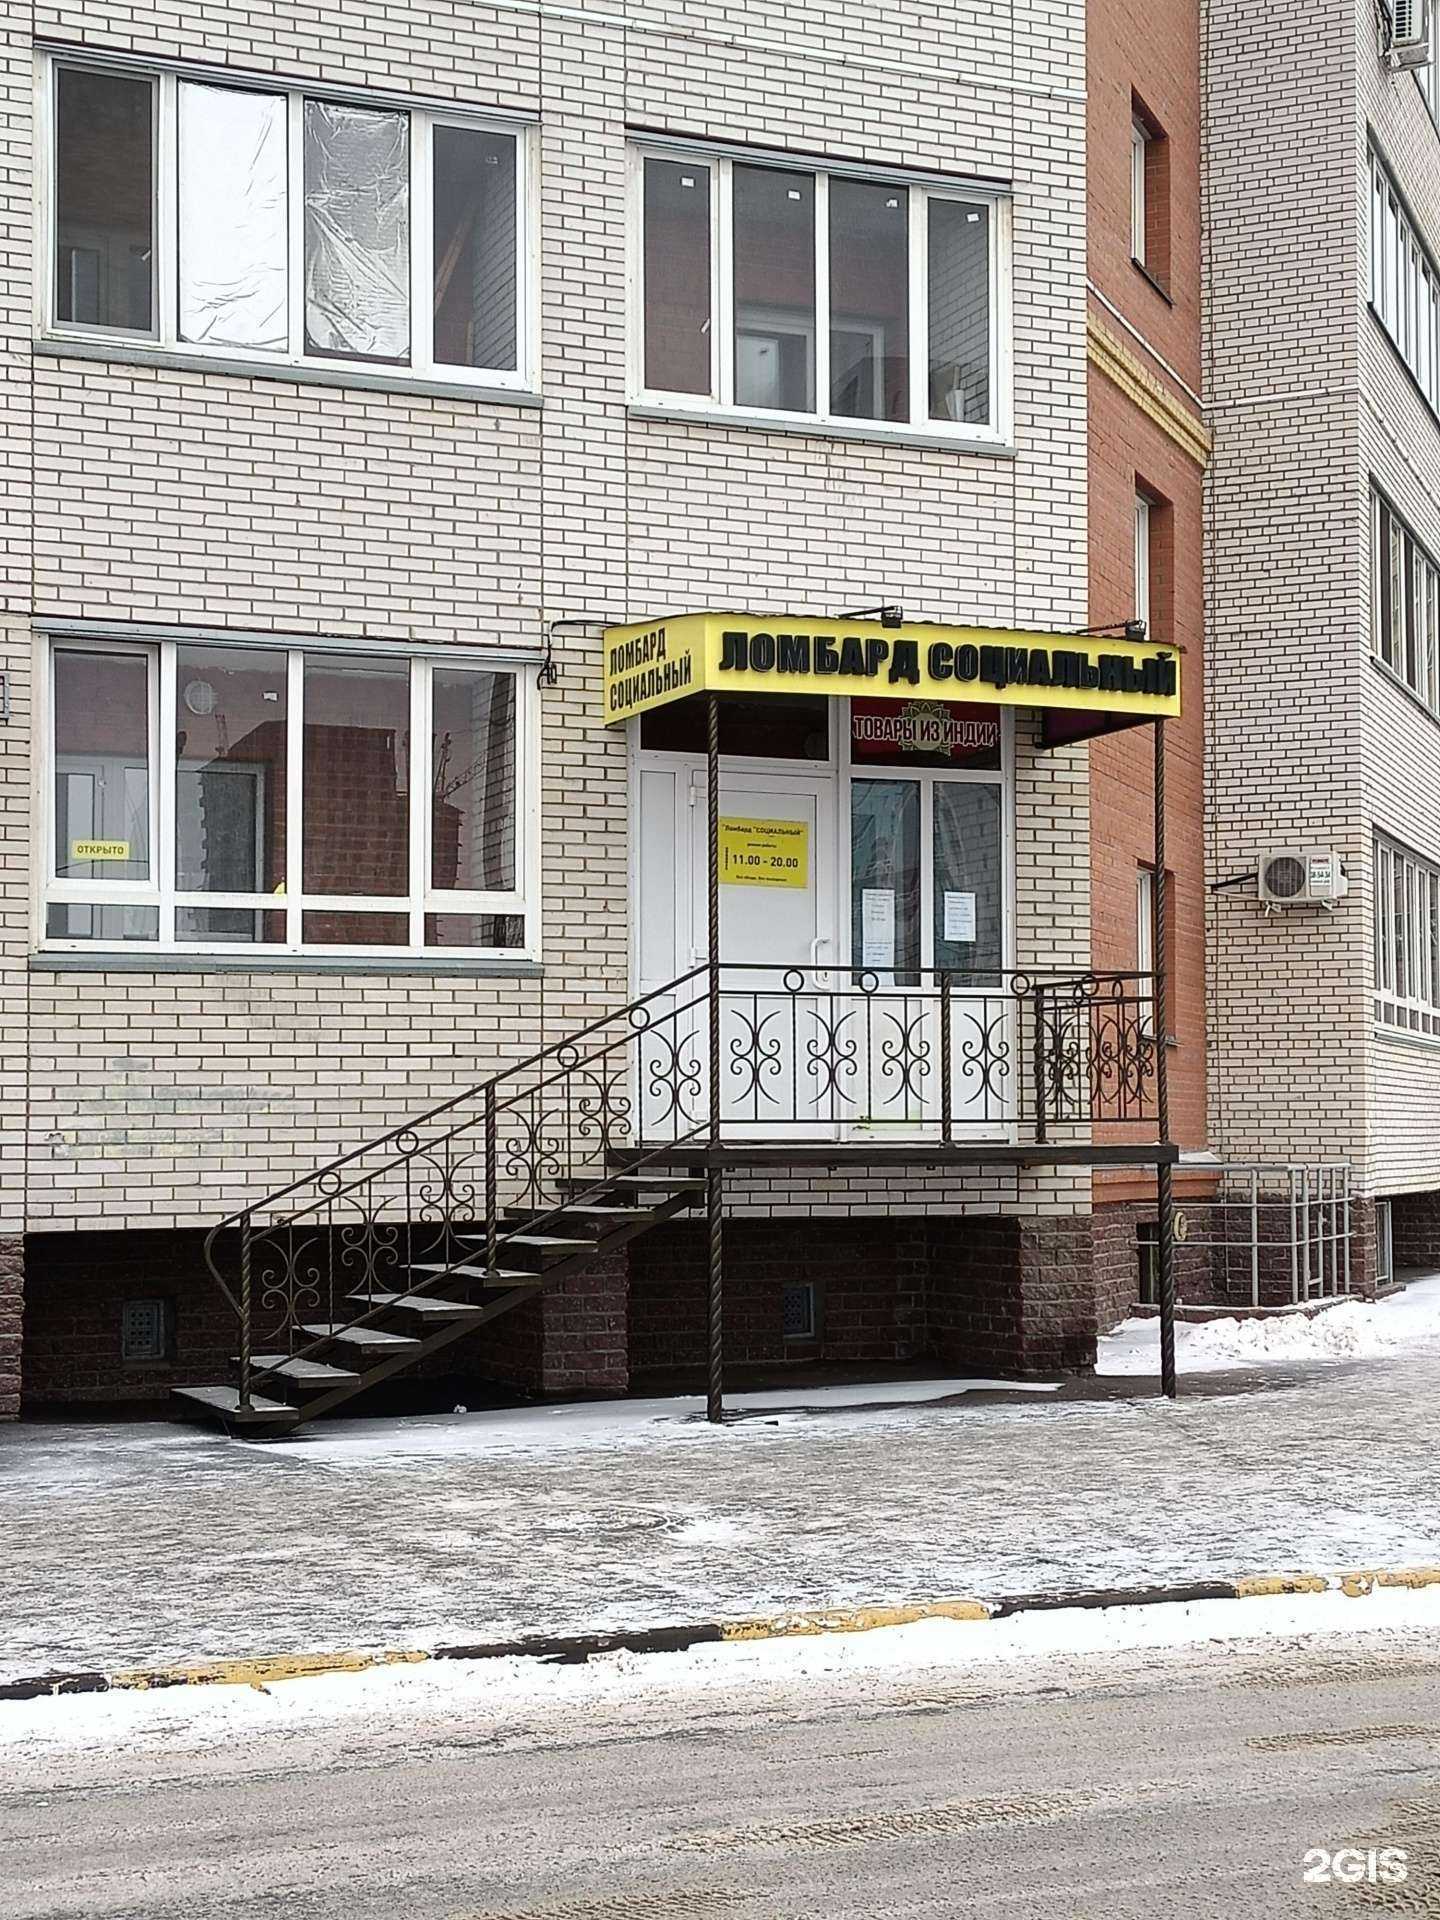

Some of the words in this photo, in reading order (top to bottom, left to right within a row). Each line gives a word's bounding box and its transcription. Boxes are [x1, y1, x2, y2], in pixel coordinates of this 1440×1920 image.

[609, 627, 667, 676] ЛОМБАРД
[719, 631, 920, 685] ЛОМБАРД
[927, 641, 1177, 696] СОЦИАЛЬНЫЙ
[609, 648, 692, 712] СОЦИАЛЬНЫЙ
[854, 715, 917, 742] ТОВАРЫ
[920, 719, 940, 742] ИЗ
[942, 719, 996, 747] ИНДИИ
[77, 845, 124, 854] ОТКРЫТО
[733, 854, 761, 866] 11.00
[770, 856, 799, 868] 20.00
